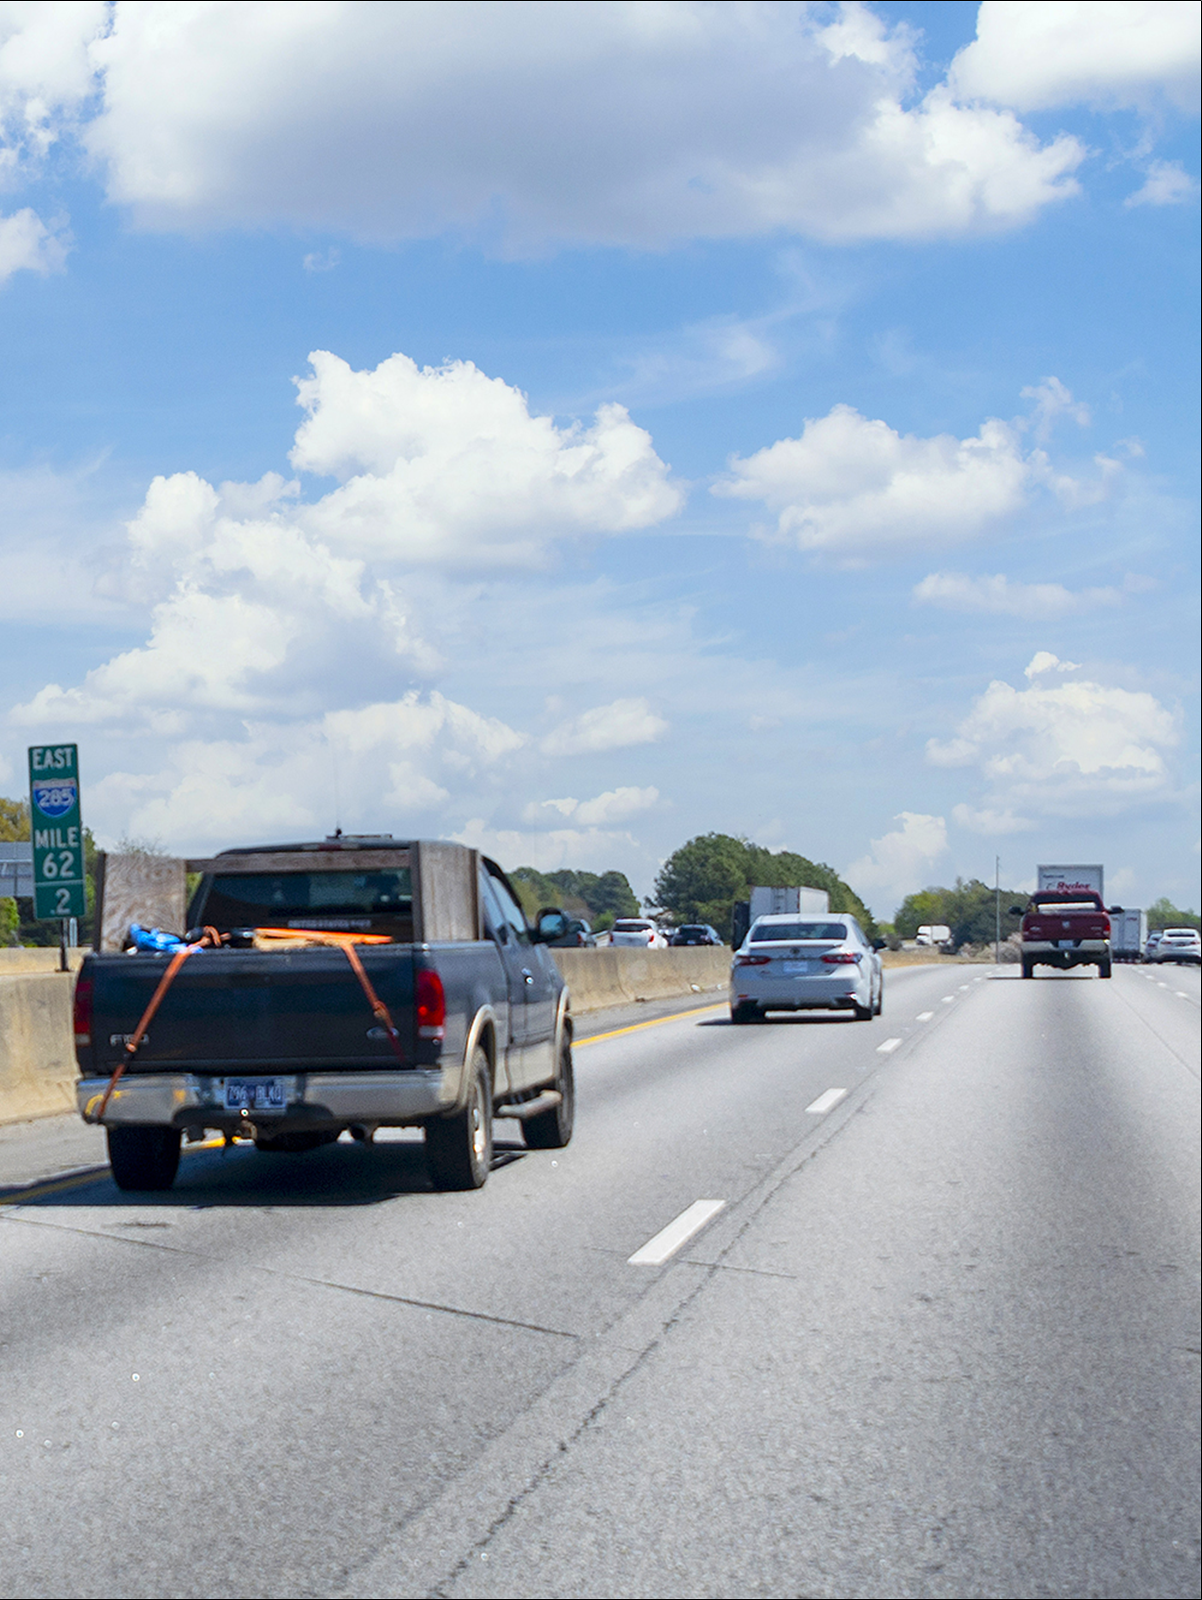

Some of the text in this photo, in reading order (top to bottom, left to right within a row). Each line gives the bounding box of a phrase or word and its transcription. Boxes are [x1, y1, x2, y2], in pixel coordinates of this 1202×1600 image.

[31, 747, 73, 770] EAST
[38, 789, 75, 808] 285
[34, 827, 79, 849] MILE
[43, 851, 75, 878] 62
